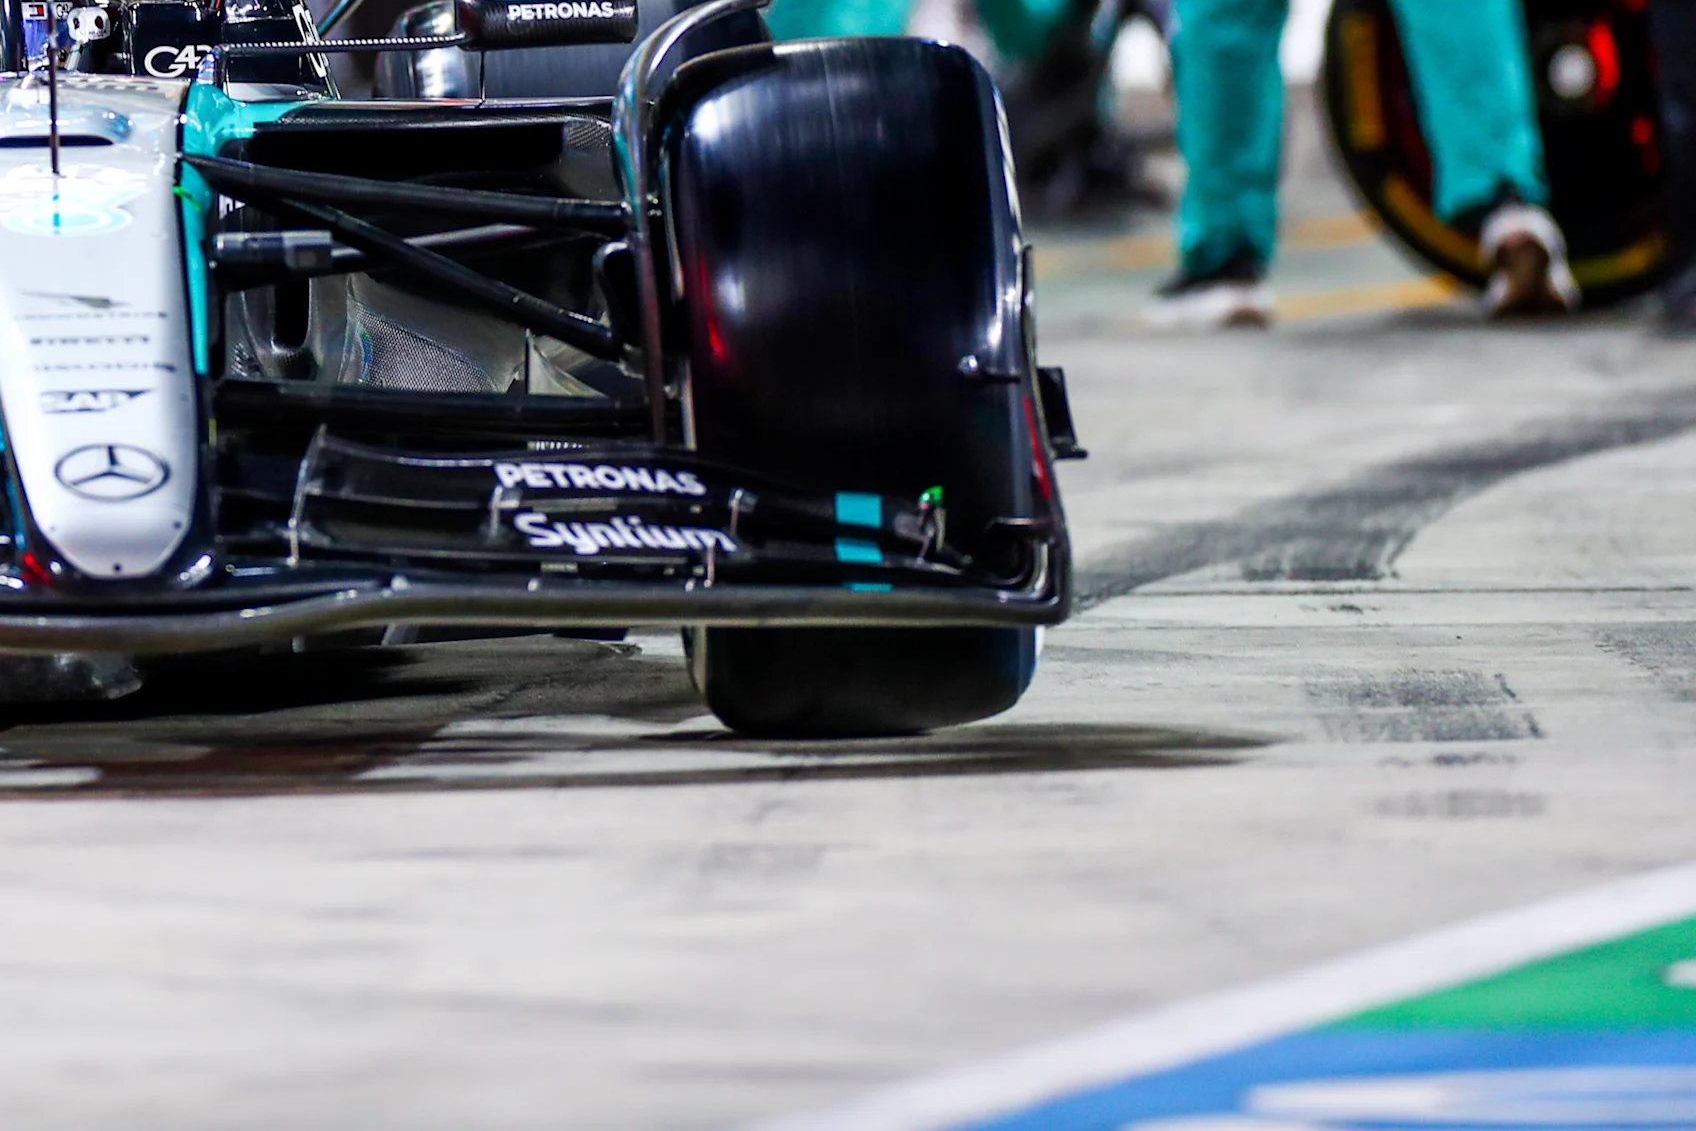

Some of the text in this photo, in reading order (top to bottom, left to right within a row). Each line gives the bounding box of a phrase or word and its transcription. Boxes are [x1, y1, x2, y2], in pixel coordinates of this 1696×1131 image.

[507, 1, 615, 21] PETRONAS
[494, 462, 706, 496] PETRONAS
[514, 513, 738, 555] Syntium
